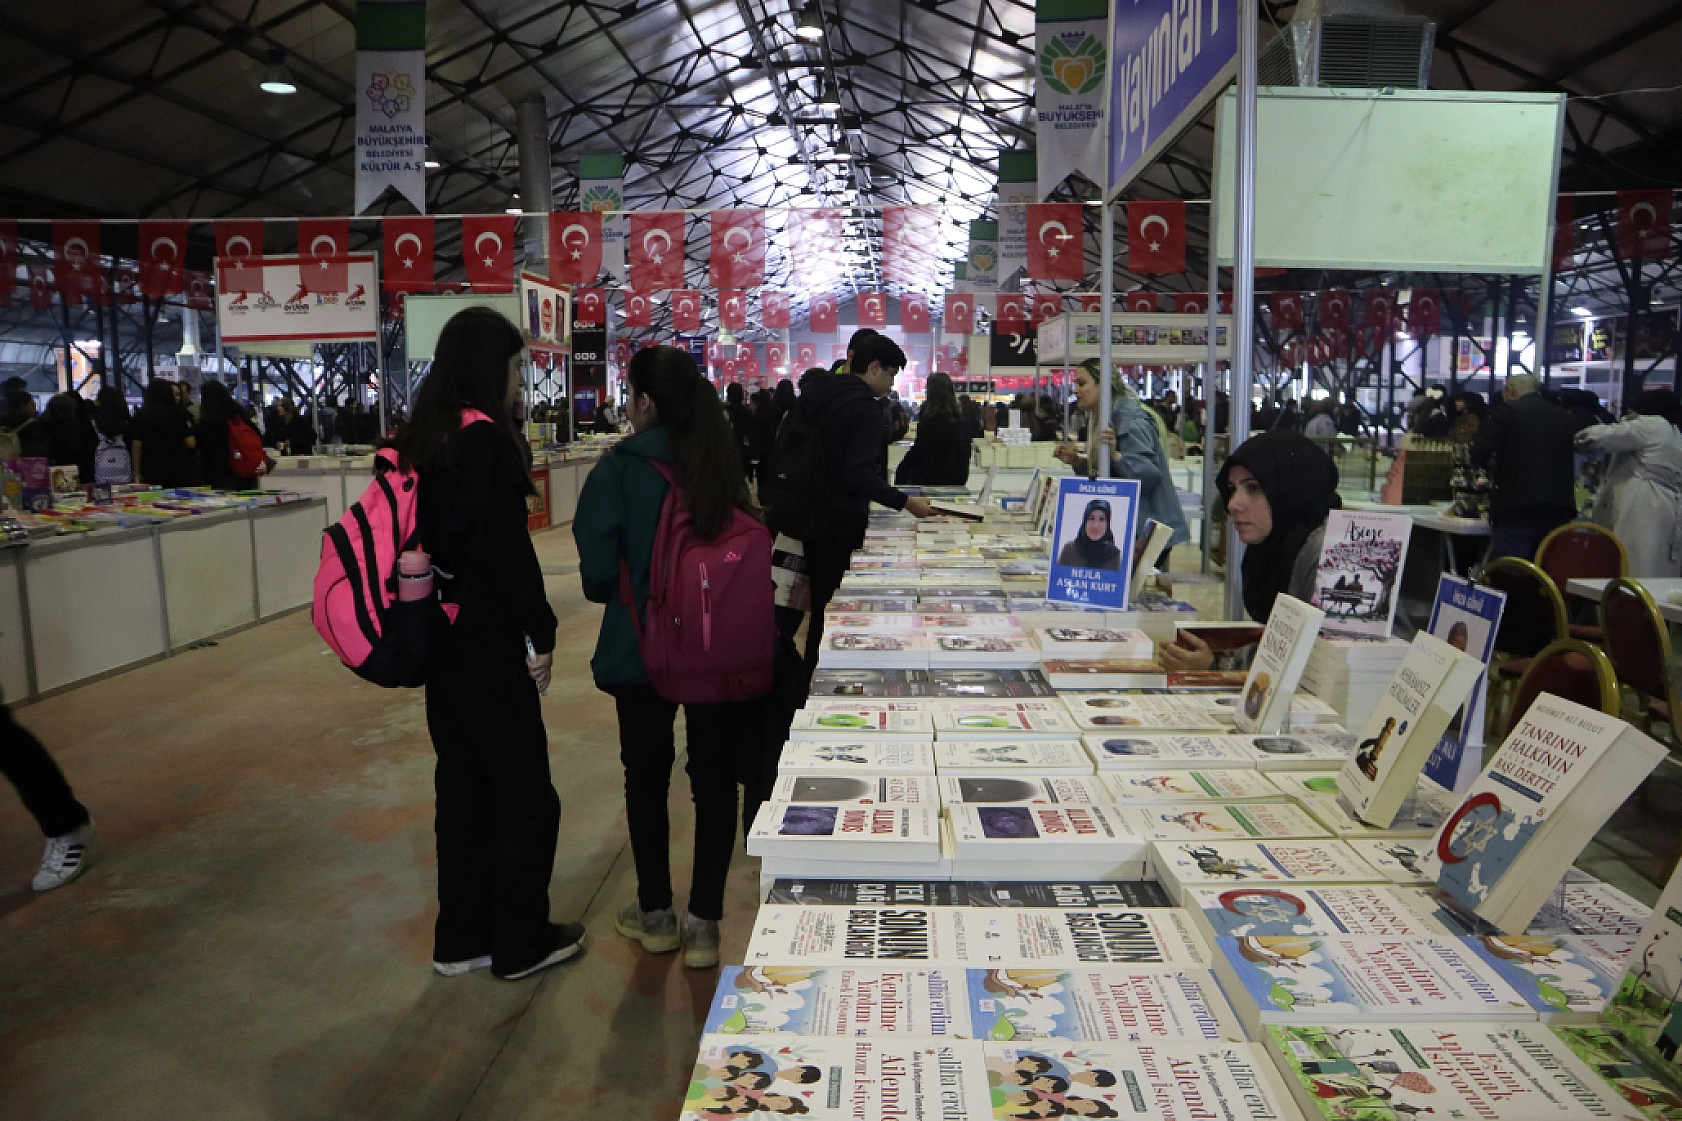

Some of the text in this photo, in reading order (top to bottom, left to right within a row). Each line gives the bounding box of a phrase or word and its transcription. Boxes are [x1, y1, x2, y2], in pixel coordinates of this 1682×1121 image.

[368, 124, 413, 133] MALATYA
[1038, 108, 1104, 122] BÜYÜKŞEHİ
[357, 134, 425, 147] BÜYÜKŞEHİR
[365, 148, 414, 158] BELEDİYESİ
[360, 160, 401, 172] KÜLTÜR
[1071, 568, 1101, 580] NEJLA
[1089, 582, 1118, 593] KURT
[1519, 721, 1588, 759] TANRININ
[1536, 704, 1565, 720] MEHMET
[1578, 718, 1606, 734] BULUT
[1513, 763, 1558, 794] DERTTE
[1339, 888, 1395, 935] HALKININ
[1360, 888, 1415, 935] TANRININ
[844, 909, 877, 958] BAŞLANGICI
[878, 909, 928, 959] SONUN
[1064, 912, 1109, 962] BAŞLANGICI
[1095, 912, 1165, 963] SONUN
[1365, 949, 1413, 994] Yardım
[1379, 941, 1448, 1001] Kendime
[855, 978, 879, 1024] Yardım
[880, 972, 904, 1033] Kendime
[929, 1001, 952, 1036] erdim
[1109, 982, 1139, 1028] Yardım
[1128, 974, 1169, 1037] Kendime
[855, 1041, 873, 1076] Huzur
[937, 1047, 963, 1086] saliha
[1137, 1046, 1160, 1081] Huzur
[1430, 1028, 1513, 1102] Anlamak
[1476, 1052, 1533, 1094] Eşimi
[1419, 1046, 1501, 1121] İstiyorum
[1553, 1073, 1612, 1118] erdim
